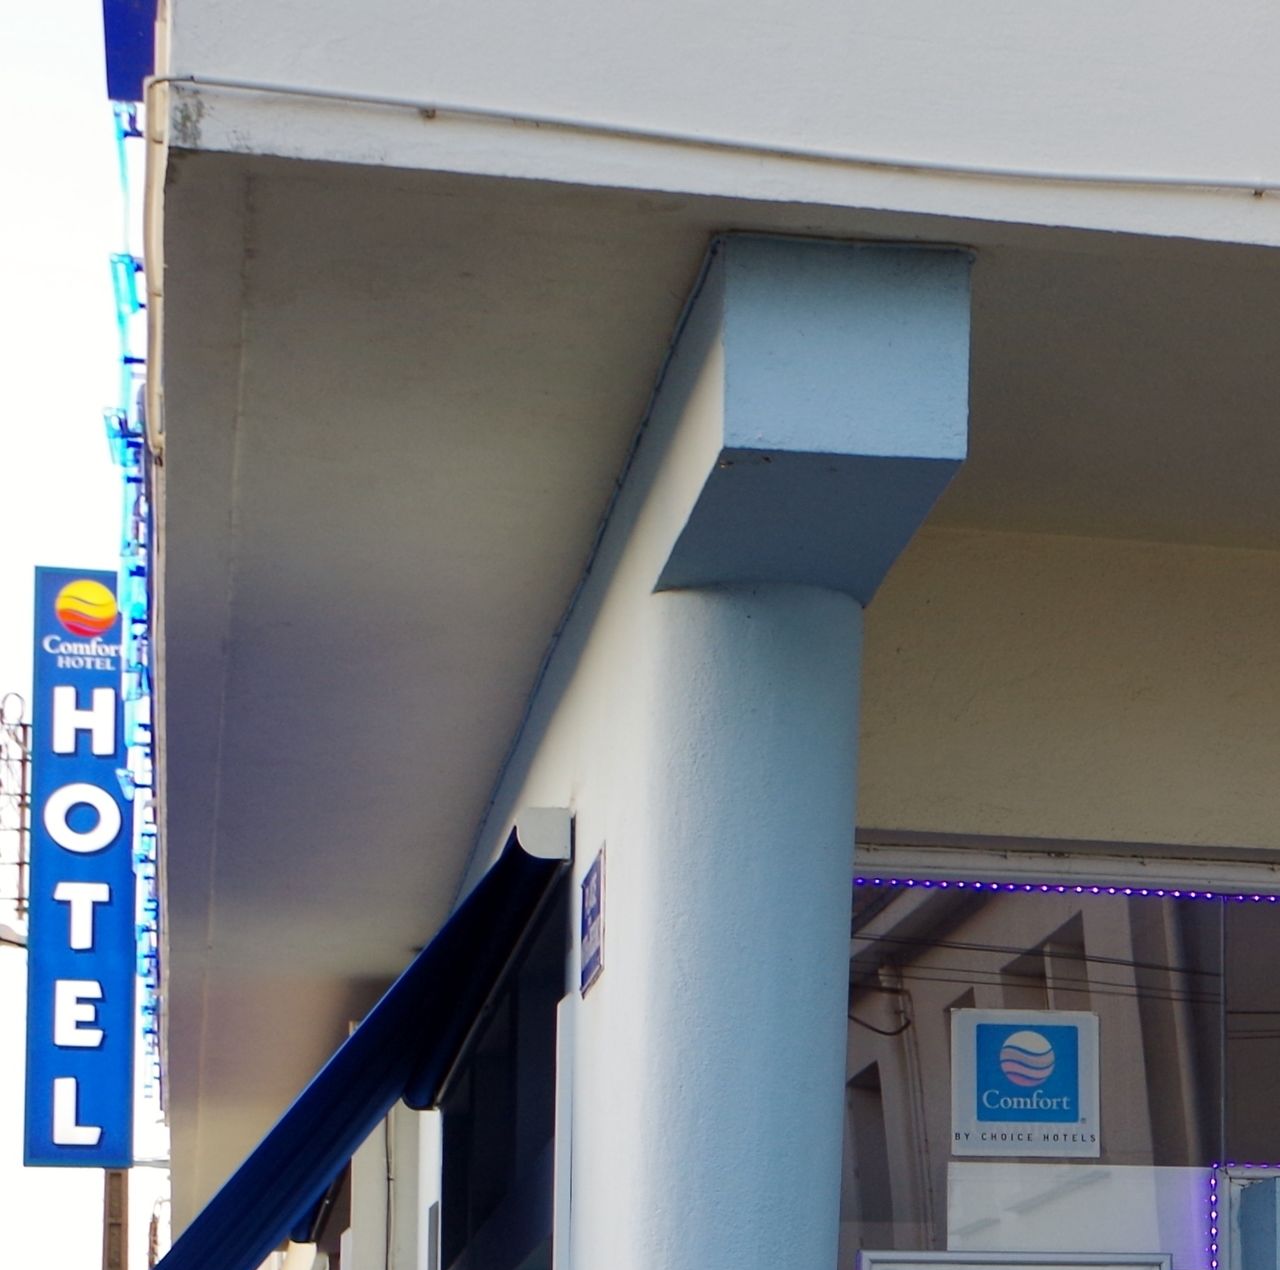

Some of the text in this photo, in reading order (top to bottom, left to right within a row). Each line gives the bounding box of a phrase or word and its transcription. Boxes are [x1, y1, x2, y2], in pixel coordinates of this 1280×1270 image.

[57, 656, 116, 671] HOTEL
[43, 685, 121, 1147] HOTEL
[982, 1089, 1071, 1111] Comfort
[954, 1133, 1096, 1143] BY CHOICE HOTELS
